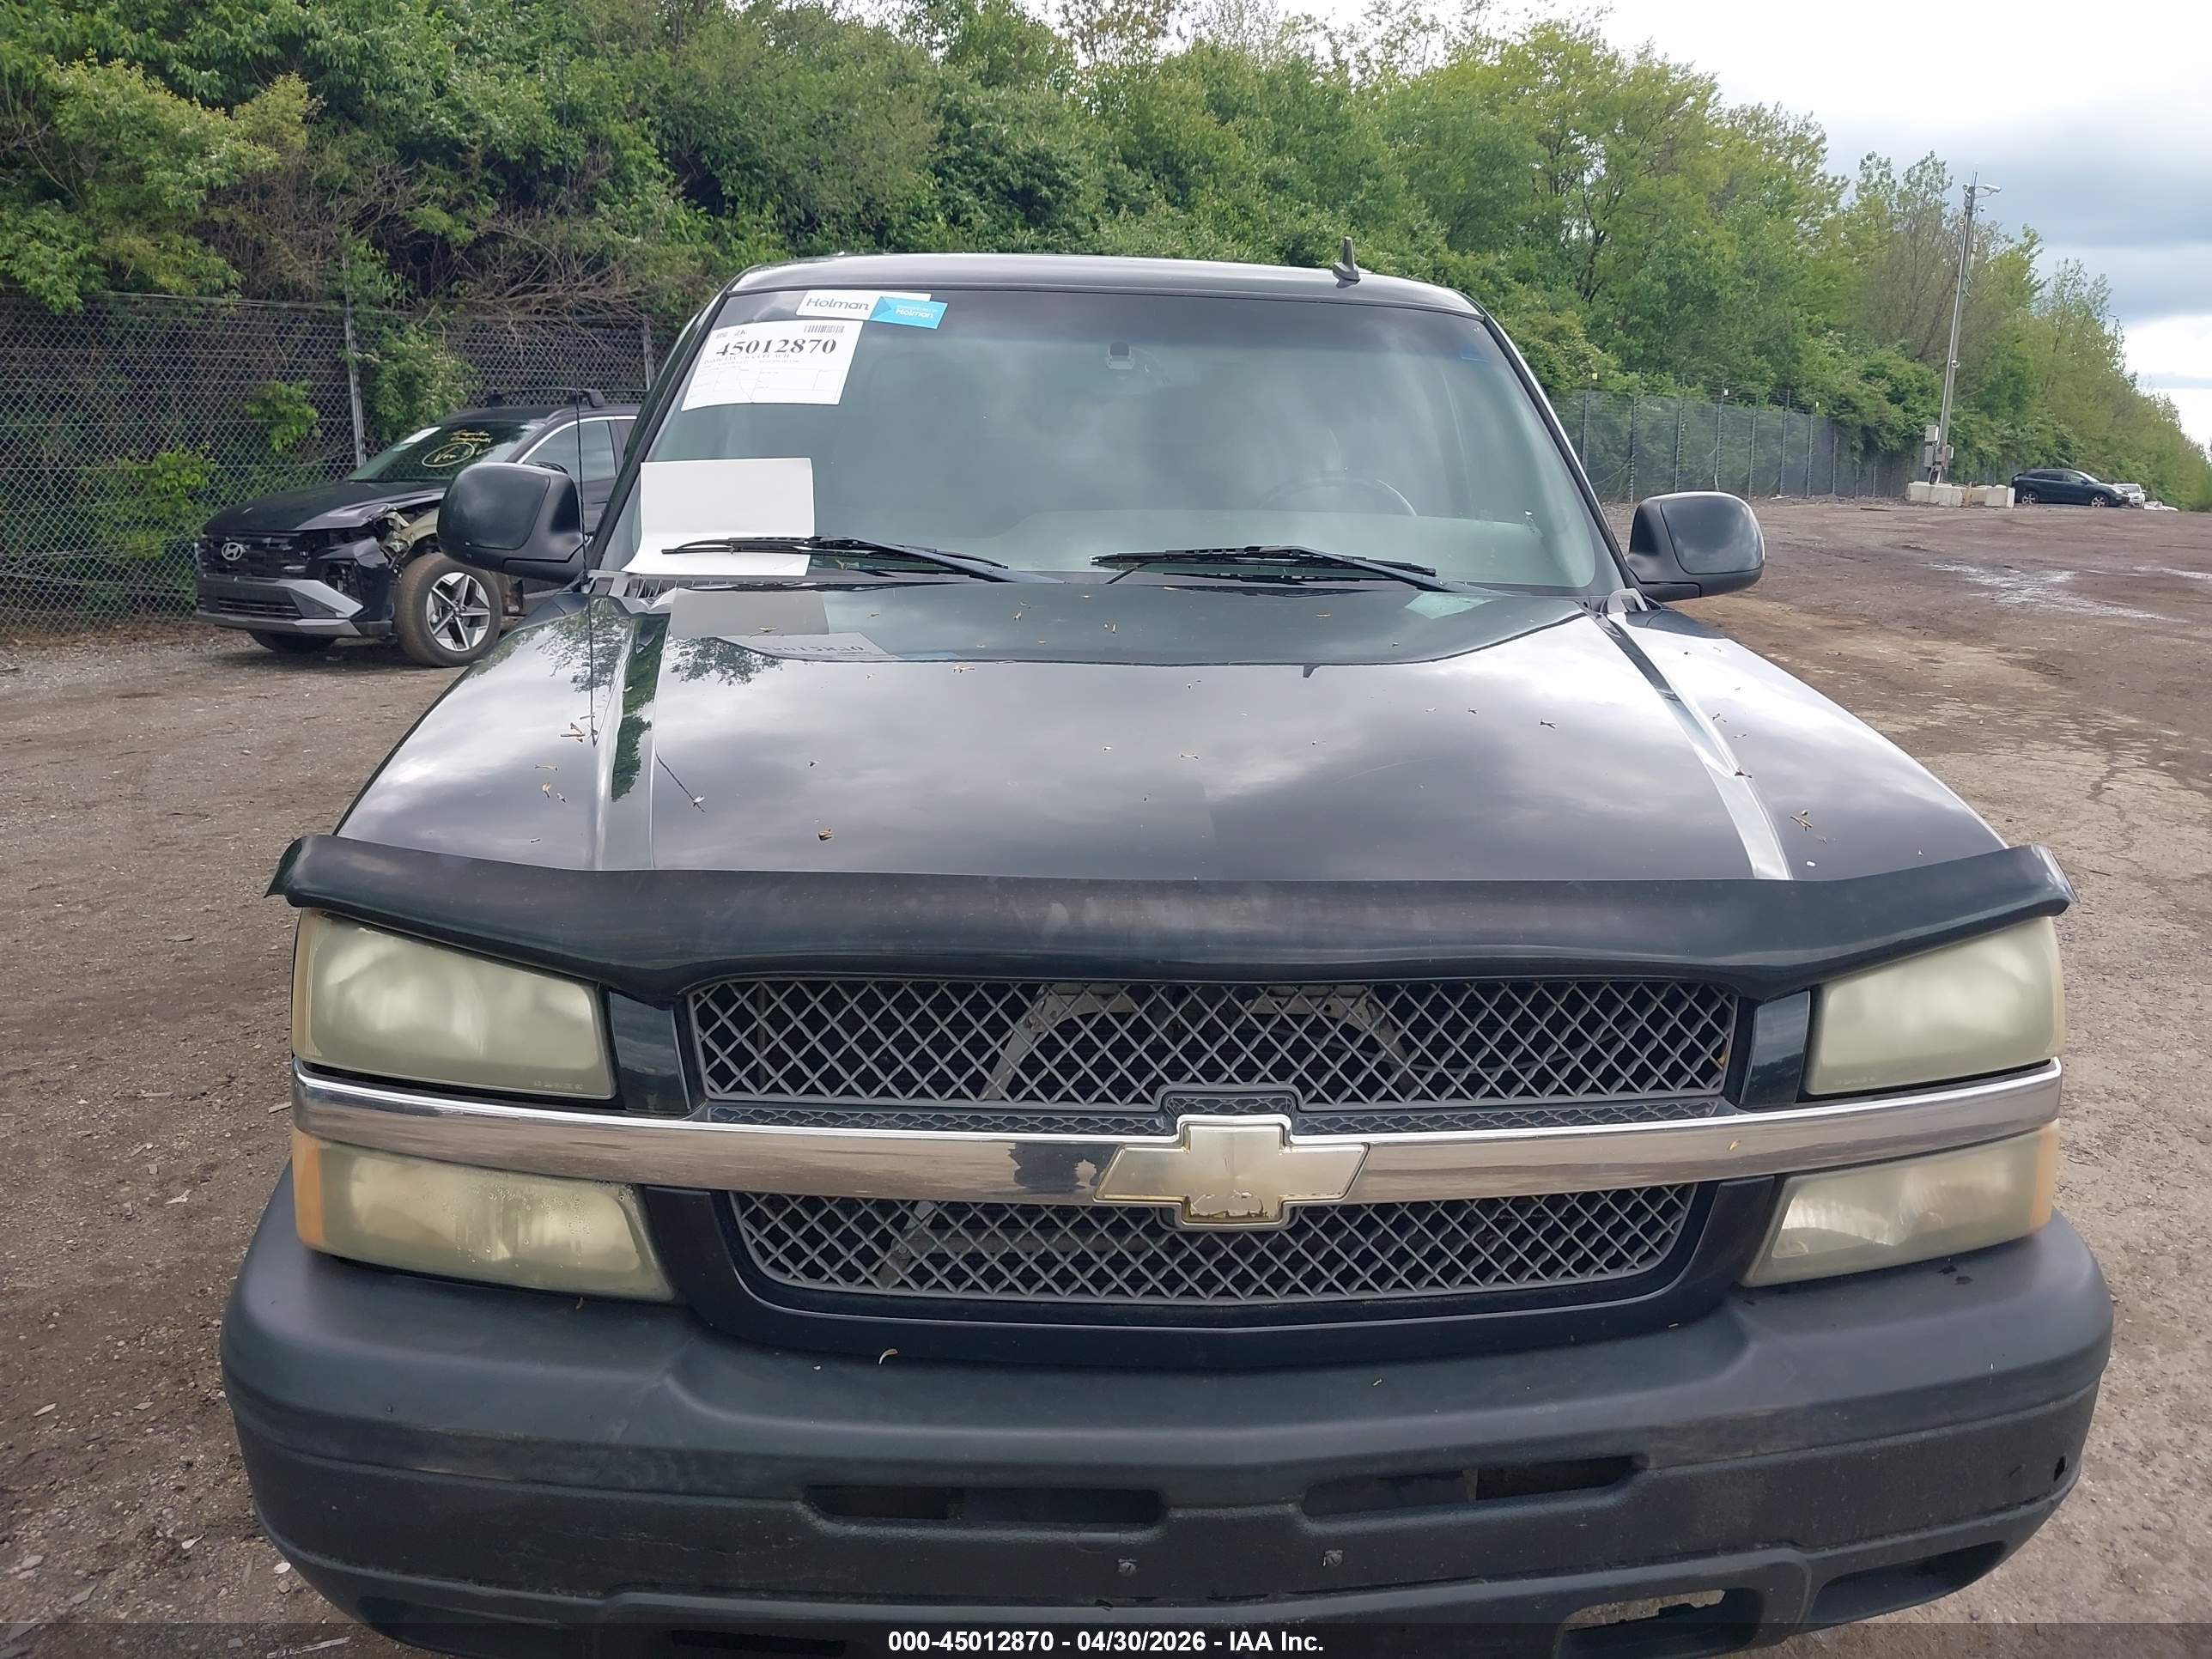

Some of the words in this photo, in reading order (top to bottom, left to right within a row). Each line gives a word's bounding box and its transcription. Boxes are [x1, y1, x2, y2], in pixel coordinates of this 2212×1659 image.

[805, 297, 870, 311] Holman
[895, 307, 935, 319] Holman
[715, 338, 837, 356] 45012870
